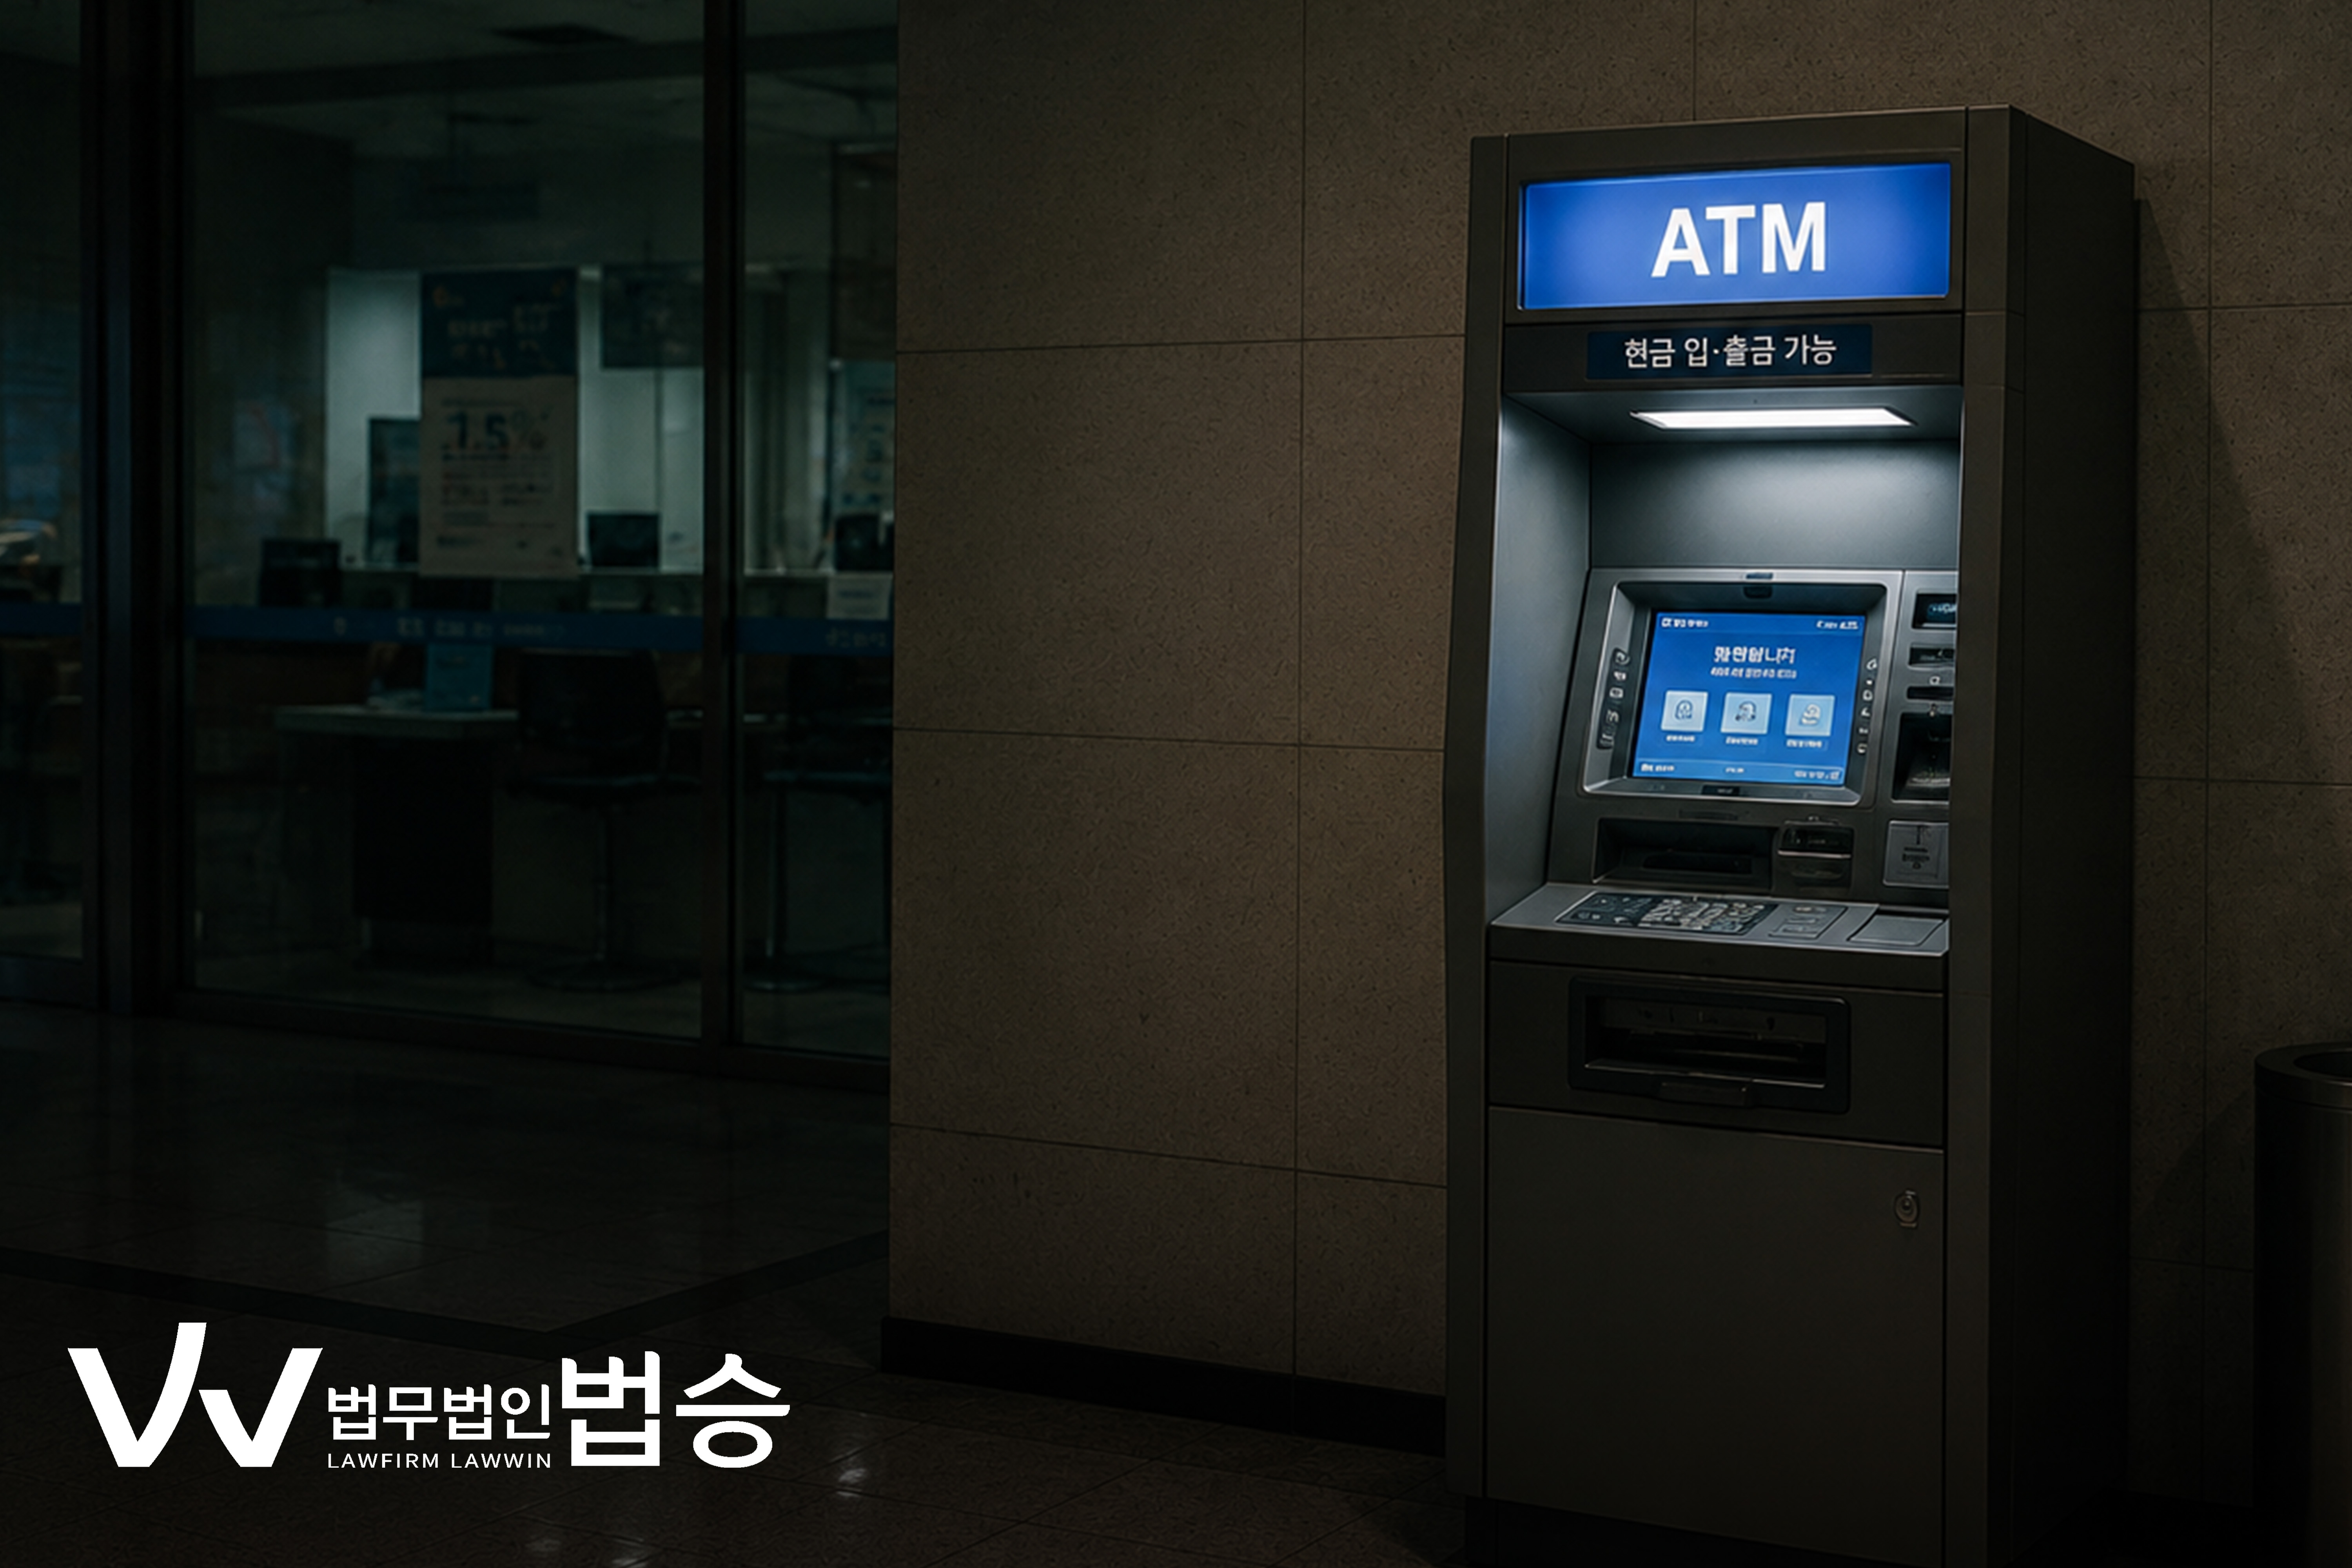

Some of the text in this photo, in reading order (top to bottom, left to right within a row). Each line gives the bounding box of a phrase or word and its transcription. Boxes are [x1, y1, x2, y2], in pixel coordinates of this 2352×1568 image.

[1651, 201, 1826, 278] ATM
[1624, 338, 1676, 368] 현금
[1784, 334, 1837, 366] 가능
